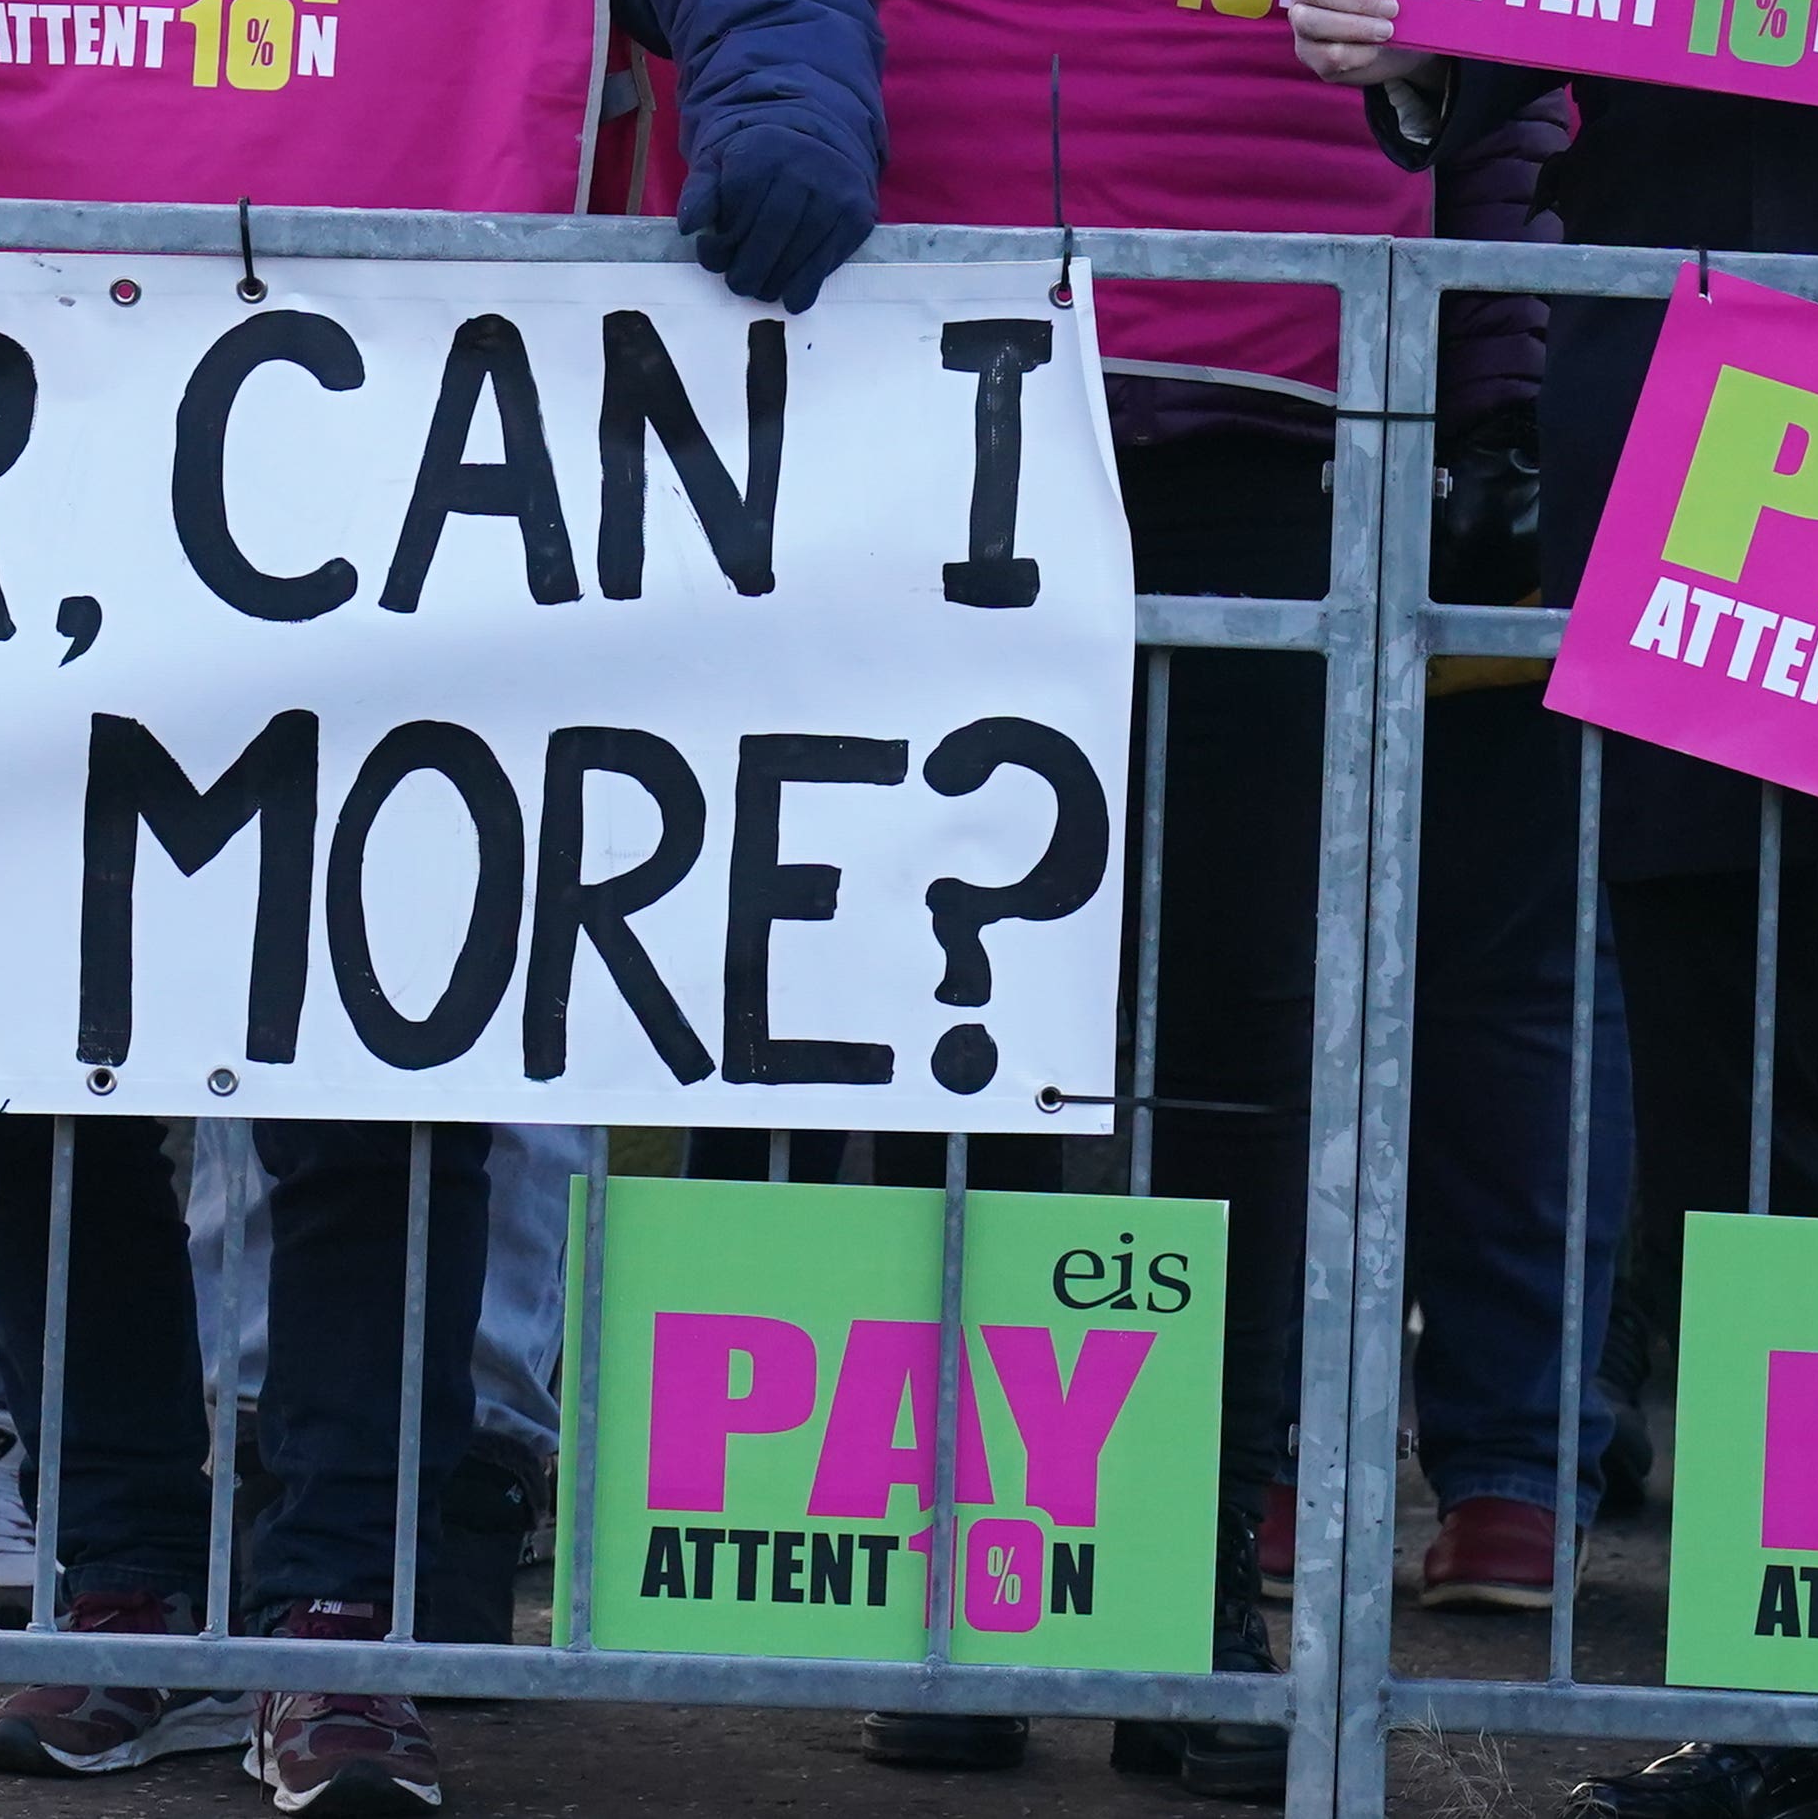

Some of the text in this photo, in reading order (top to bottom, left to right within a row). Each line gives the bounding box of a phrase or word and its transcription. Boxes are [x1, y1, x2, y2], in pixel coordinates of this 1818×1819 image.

[171, 309, 788, 622] CAN
[941, 317, 1054, 609] I
[79, 708, 1111, 1096] MORE?
[1052, 1232, 1193, 1313] eis
[646, 1311, 1159, 1528] PAY
